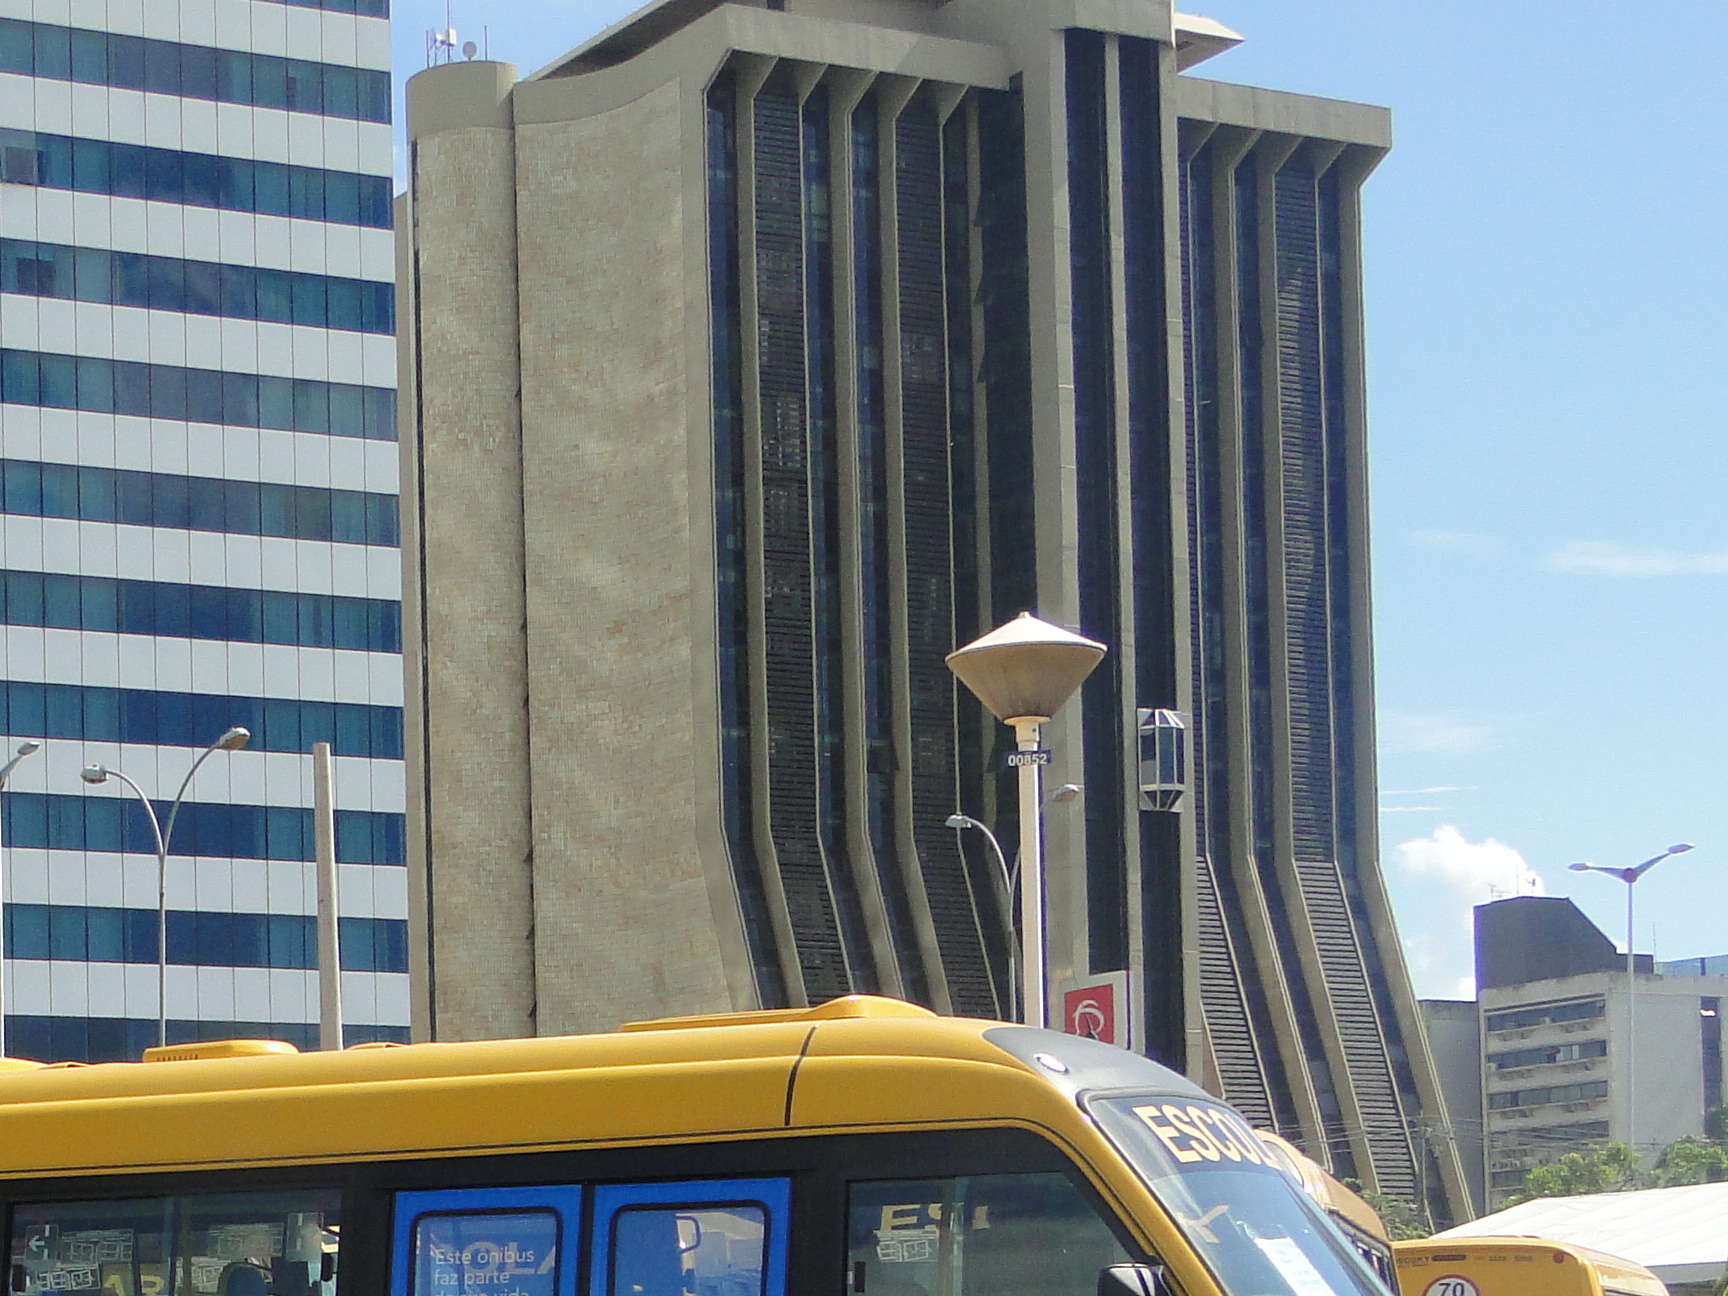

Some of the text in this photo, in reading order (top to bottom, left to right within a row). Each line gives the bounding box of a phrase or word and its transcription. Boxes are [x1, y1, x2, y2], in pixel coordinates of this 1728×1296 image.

[1007, 753, 1048, 767] 00852
[435, 1246, 535, 1265] Este ônibus
[434, 1269, 510, 1290] faz parte
